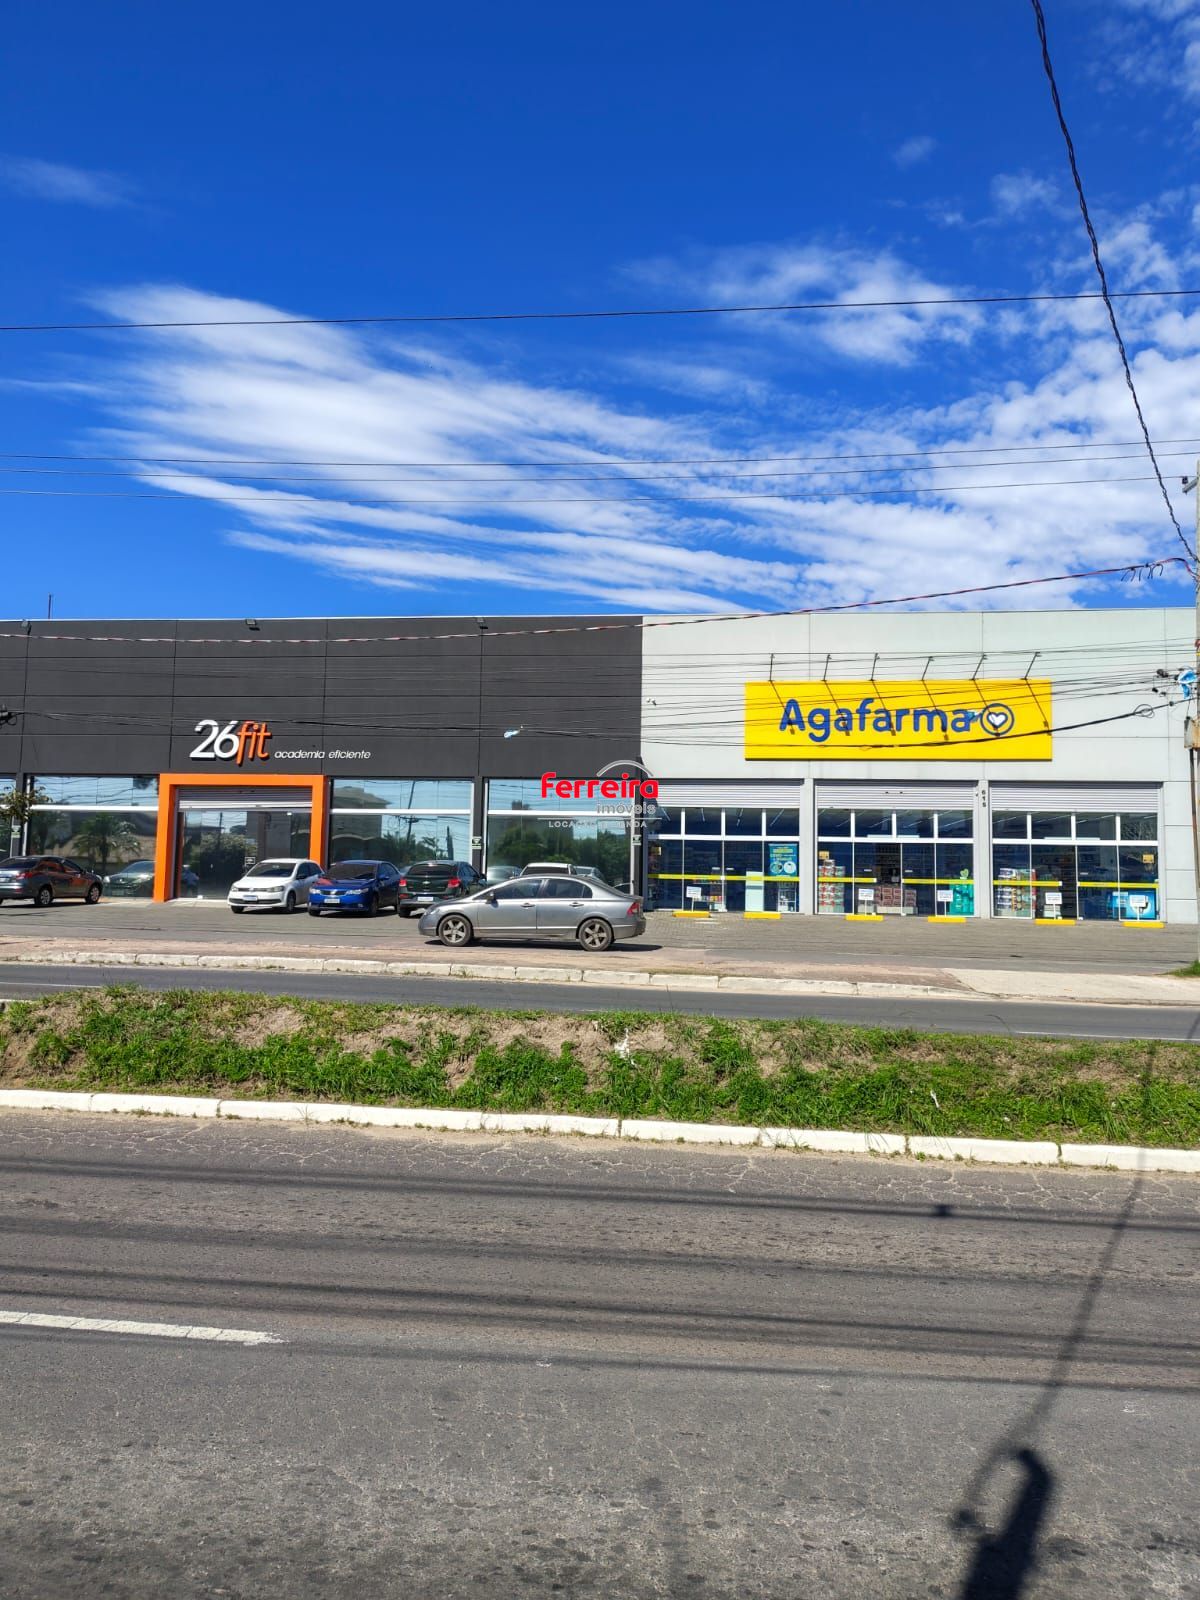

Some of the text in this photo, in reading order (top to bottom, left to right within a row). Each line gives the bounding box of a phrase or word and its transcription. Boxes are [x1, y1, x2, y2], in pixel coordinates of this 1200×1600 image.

[779, 698, 971, 743] Agafarma
[274, 749, 371, 759] academia eficiente
